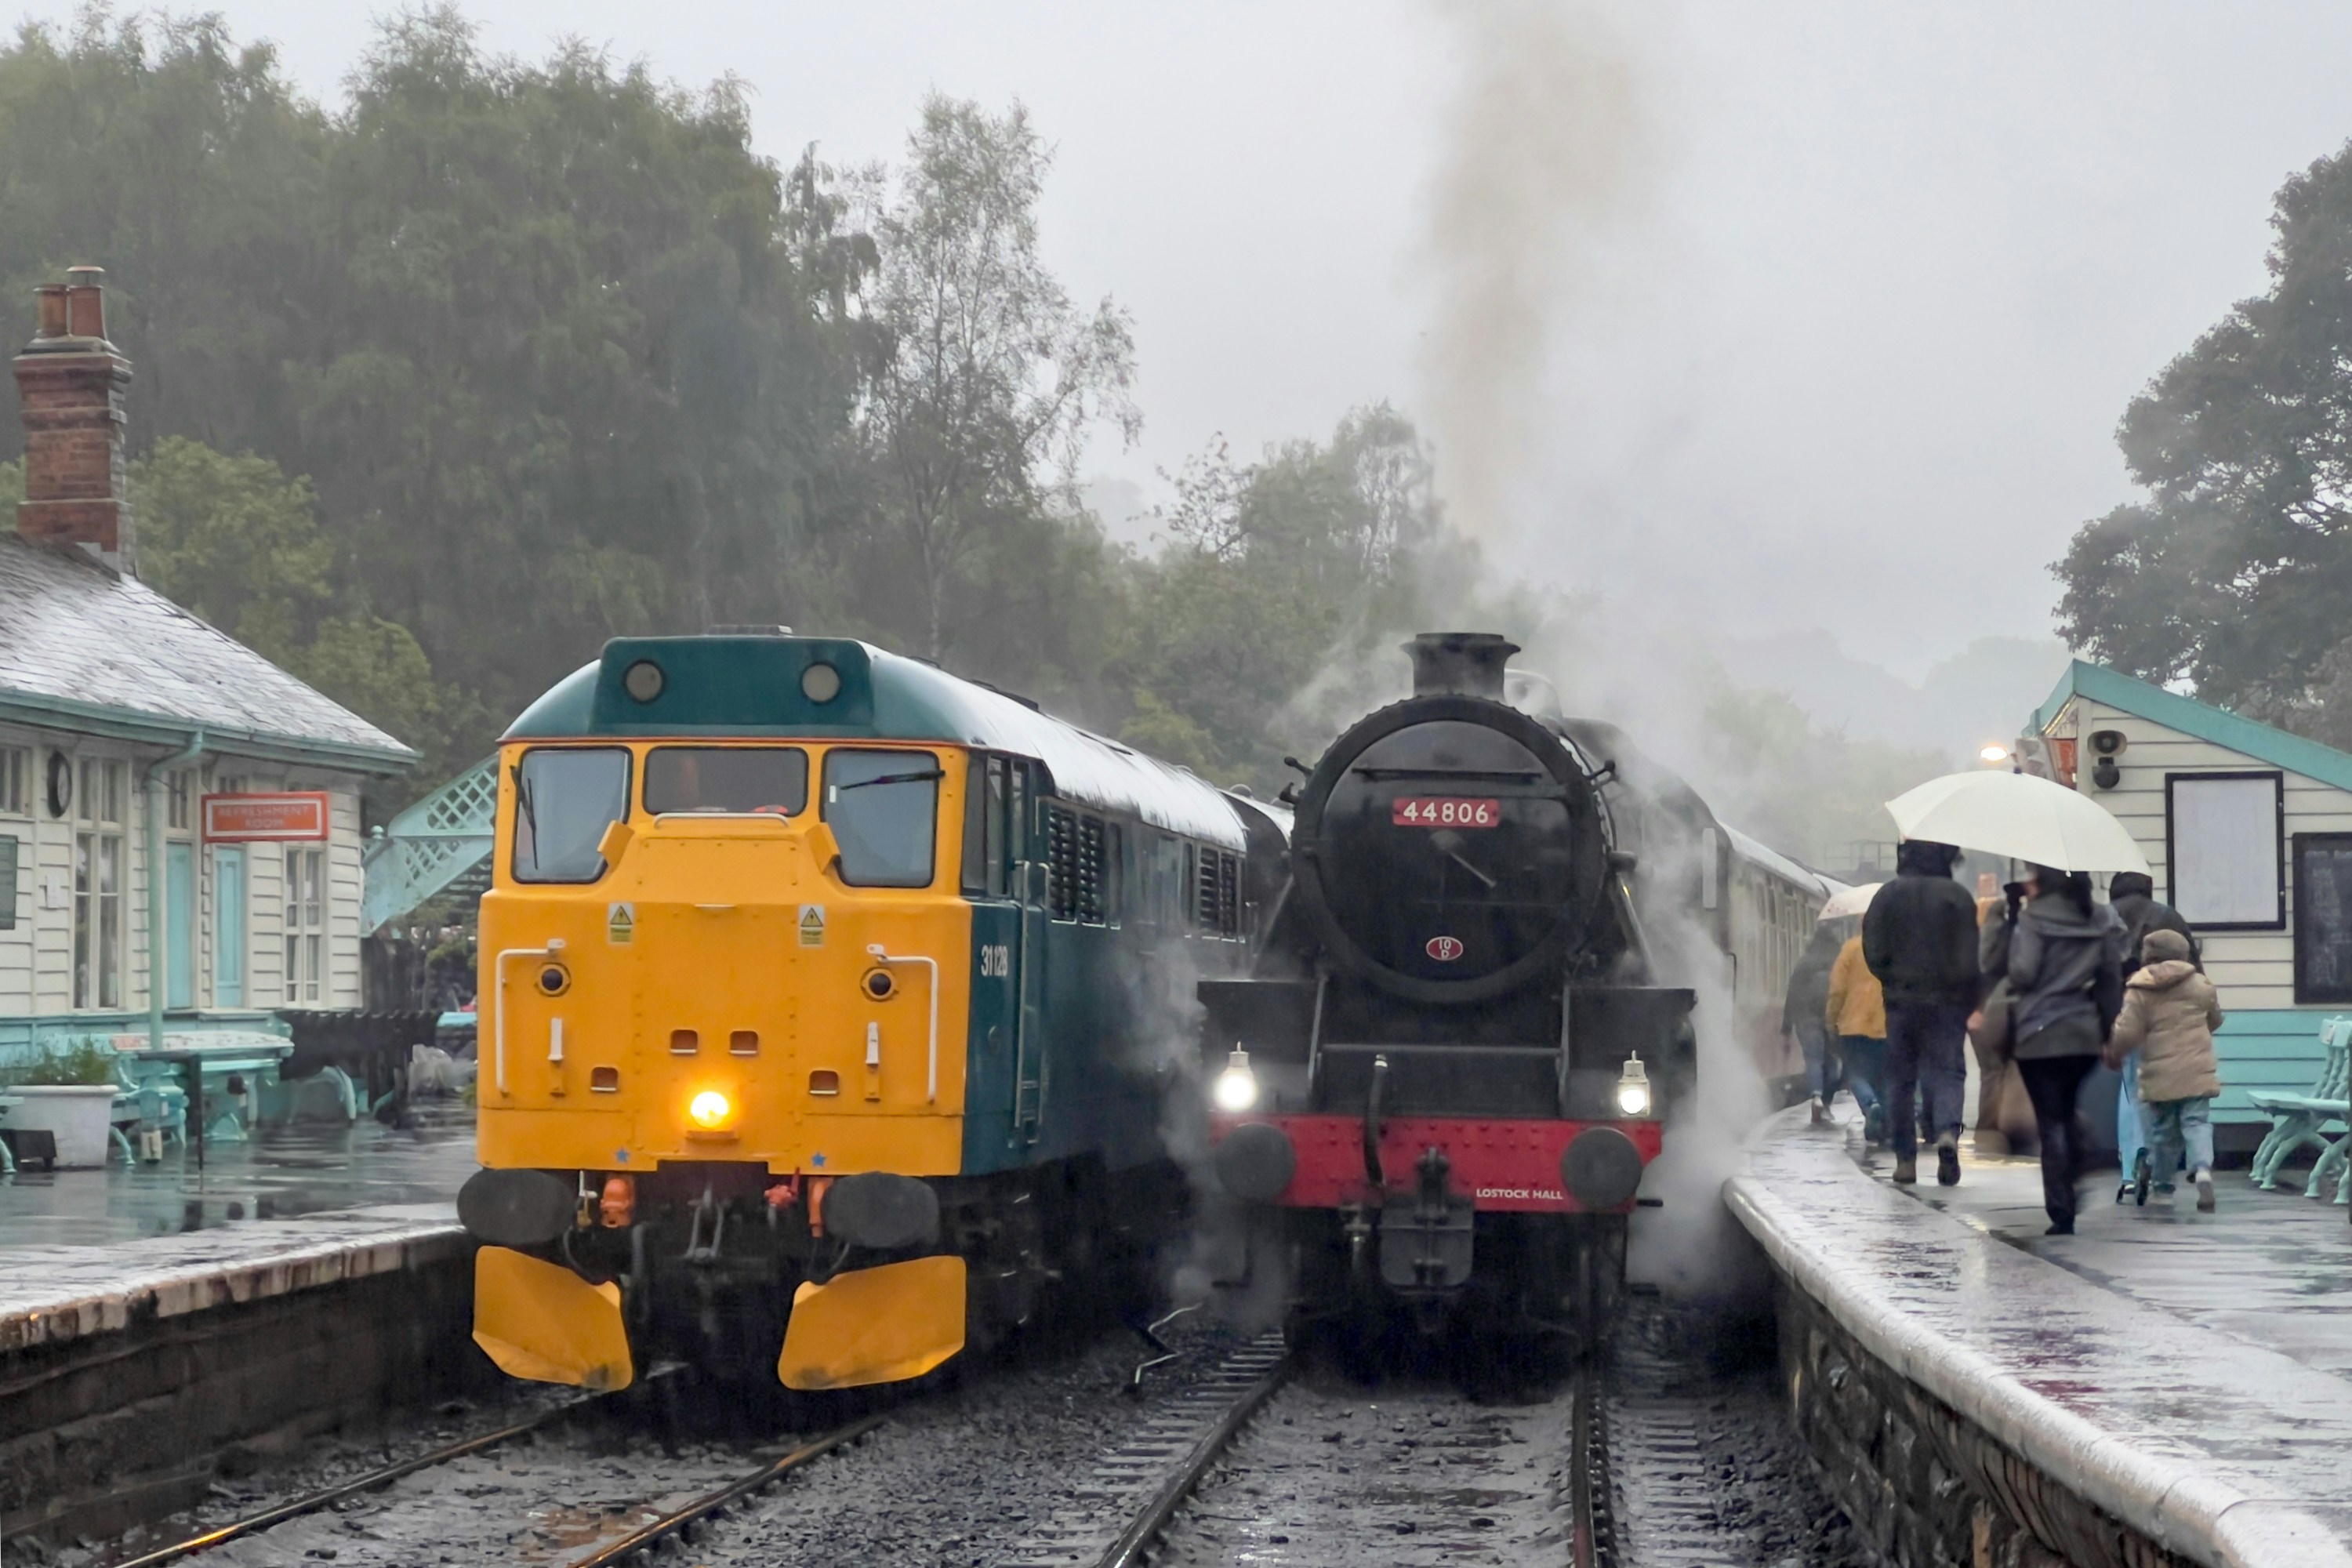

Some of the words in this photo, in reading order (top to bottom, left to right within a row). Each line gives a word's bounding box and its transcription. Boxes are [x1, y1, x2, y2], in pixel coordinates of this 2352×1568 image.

[218, 806, 309, 817] REFRESHMENT
[1403, 801, 1489, 823] 44806
[245, 818, 284, 829] ROOM
[1439, 938, 1451, 949] 10
[981, 944, 1008, 977] 31128
[1476, 1188, 1530, 1199] LOSTOCK
[1533, 1189, 1563, 1200] HALL
